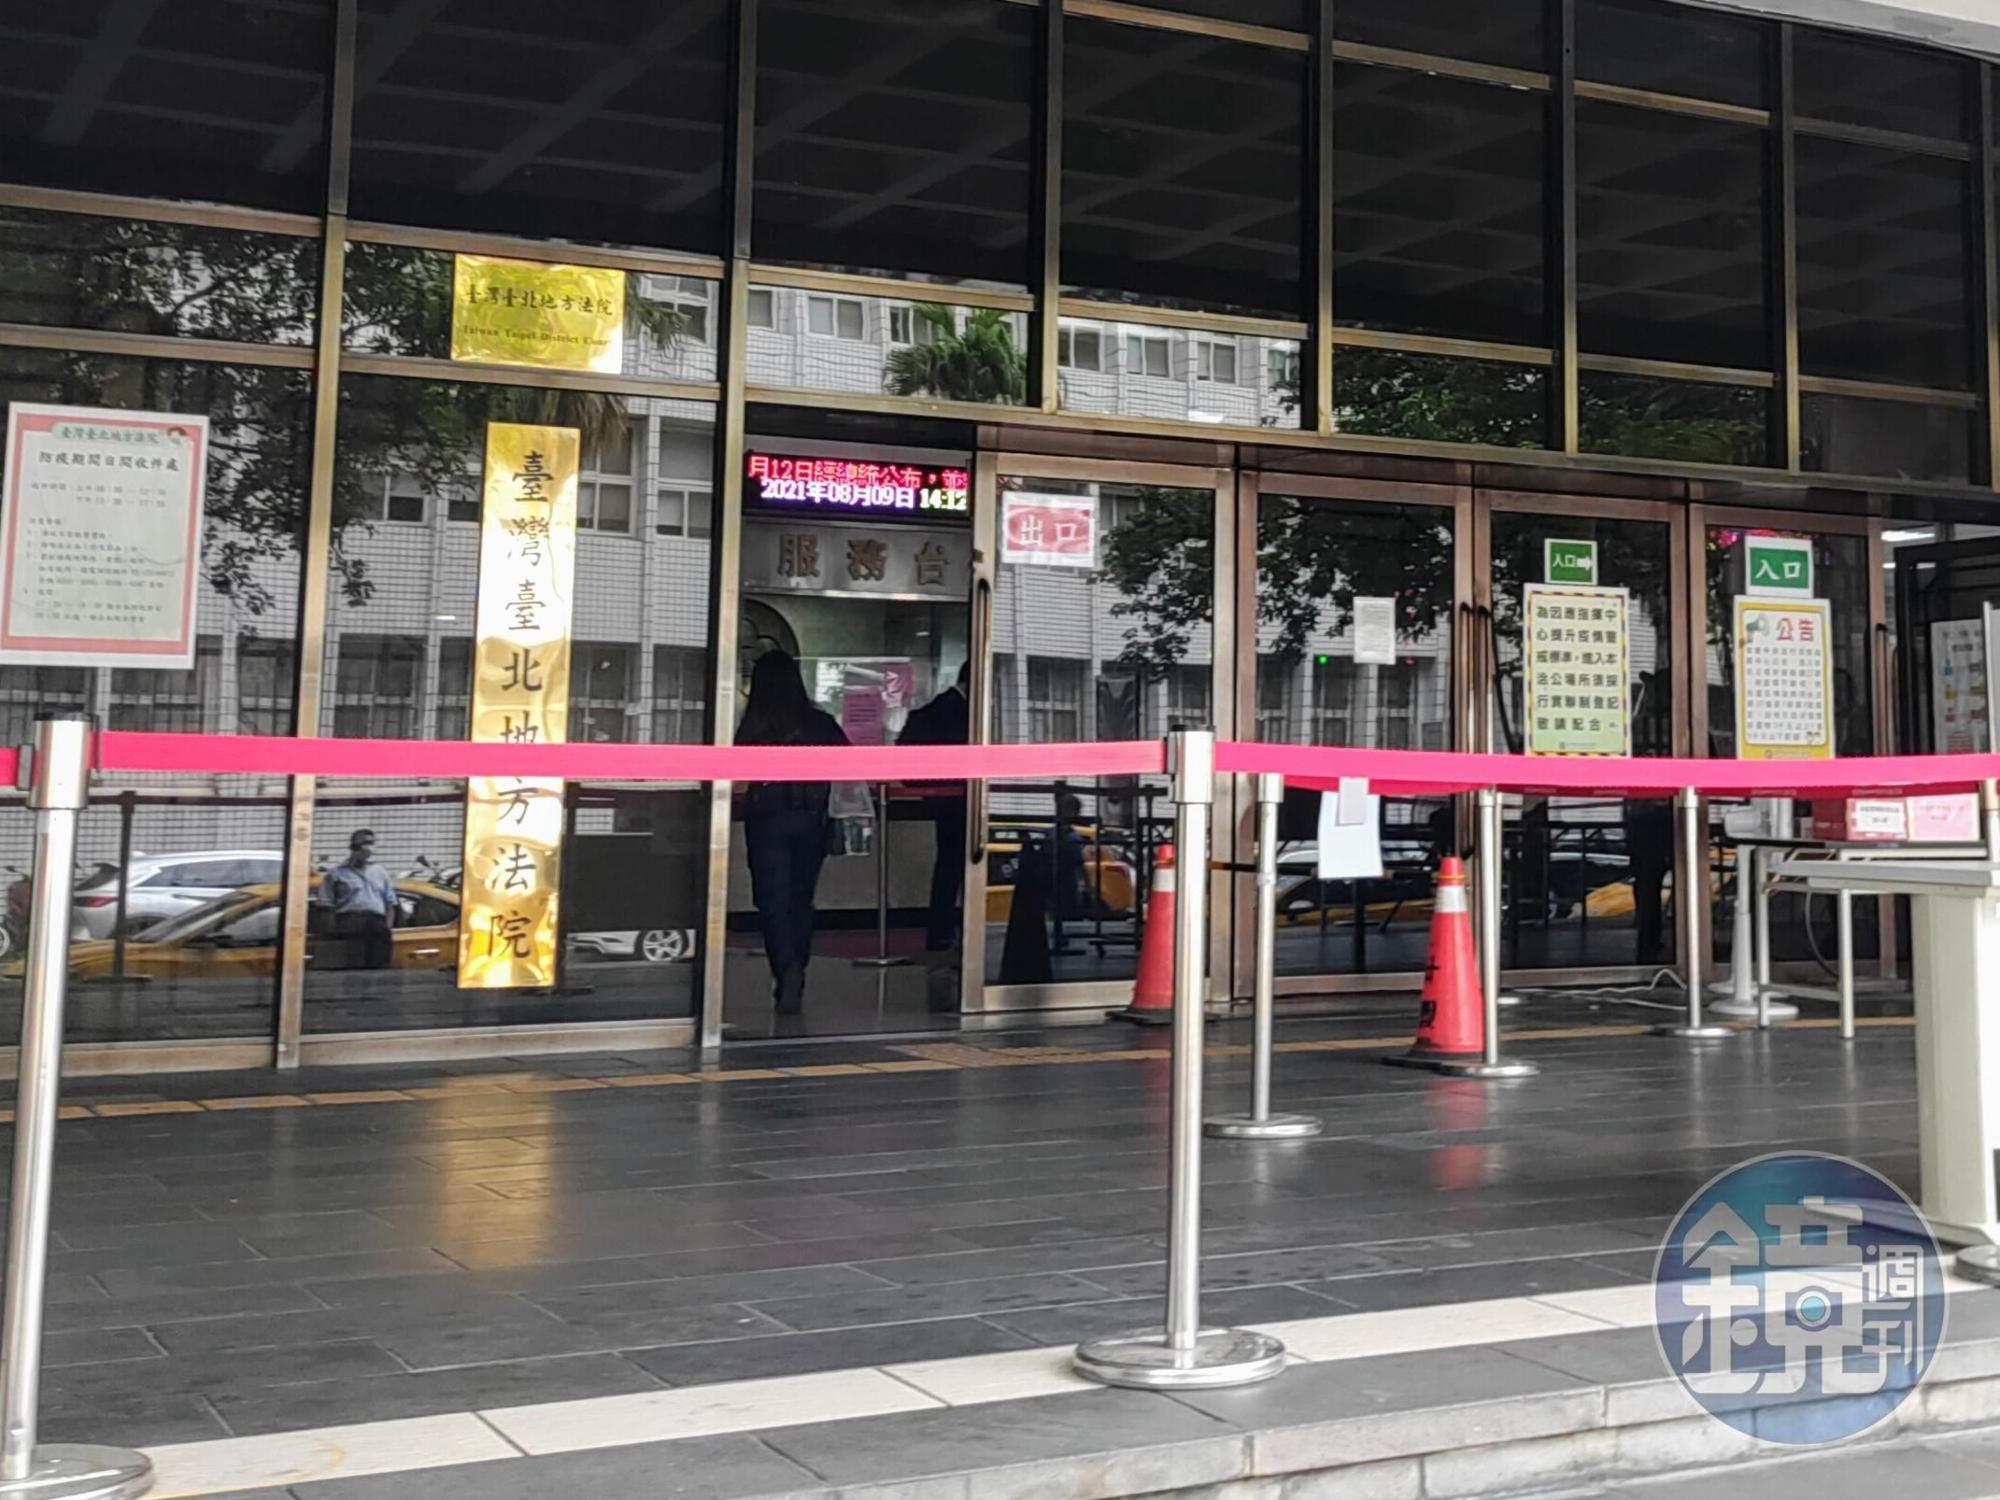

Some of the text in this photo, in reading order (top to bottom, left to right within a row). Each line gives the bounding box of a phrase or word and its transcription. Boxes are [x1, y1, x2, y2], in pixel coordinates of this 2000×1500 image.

[467, 285, 613, 316] 臺灣臺北地方法院
[39, 452, 179, 472] 防疫期間日間收件處
[760, 478, 967, 512] 2021年08月09日 14:12
[1019, 514, 1078, 547] 出口
[778, 533, 949, 586] 服務台
[1552, 554, 1576, 569] 入口
[1755, 559, 1802, 581] 入口
[1536, 605, 1618, 622] 為因應指揮中
[1776, 617, 1815, 642] 公告
[1537, 694, 1619, 710] 行實聯制登記
